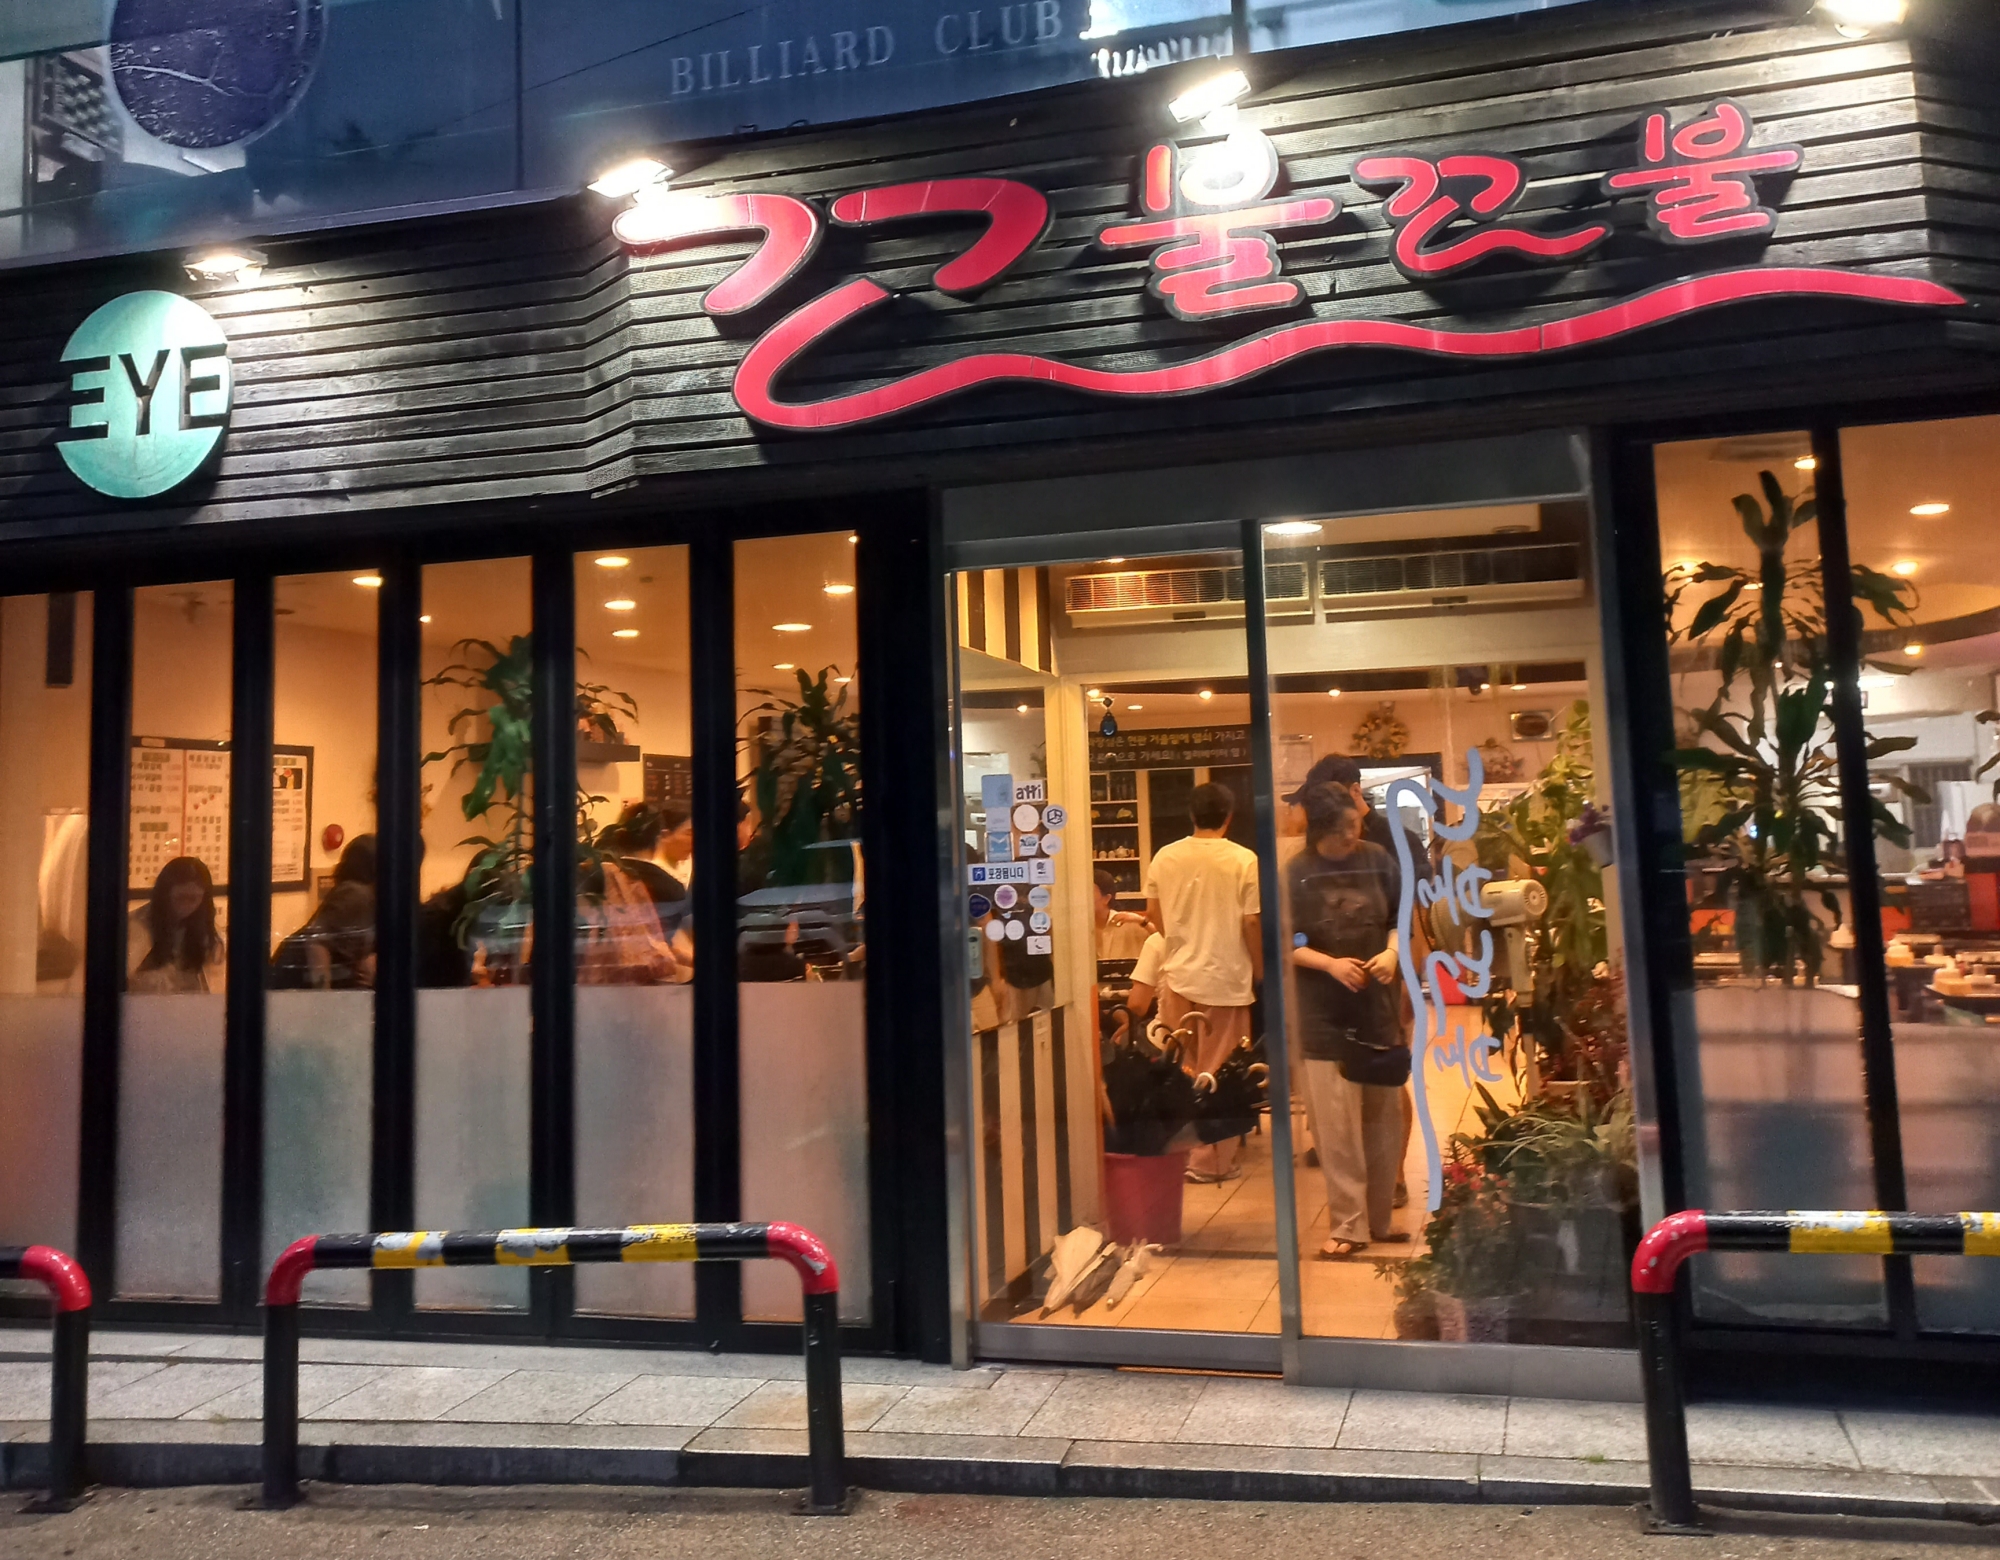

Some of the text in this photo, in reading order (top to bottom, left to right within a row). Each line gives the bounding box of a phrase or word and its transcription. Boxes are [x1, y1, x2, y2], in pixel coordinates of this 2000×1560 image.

[671, 0, 1063, 95] BILLIARD CLUB
[612, 102, 1967, 429] 꼬불꼬불
[59, 342, 228, 440] EYE
[1089, 752, 1136, 764] 오른으로
[1215, 729, 1246, 743] 가지고
[988, 866, 1024, 880] 포장됩니다
[1386, 747, 1503, 1213] 꼬불꼬불
